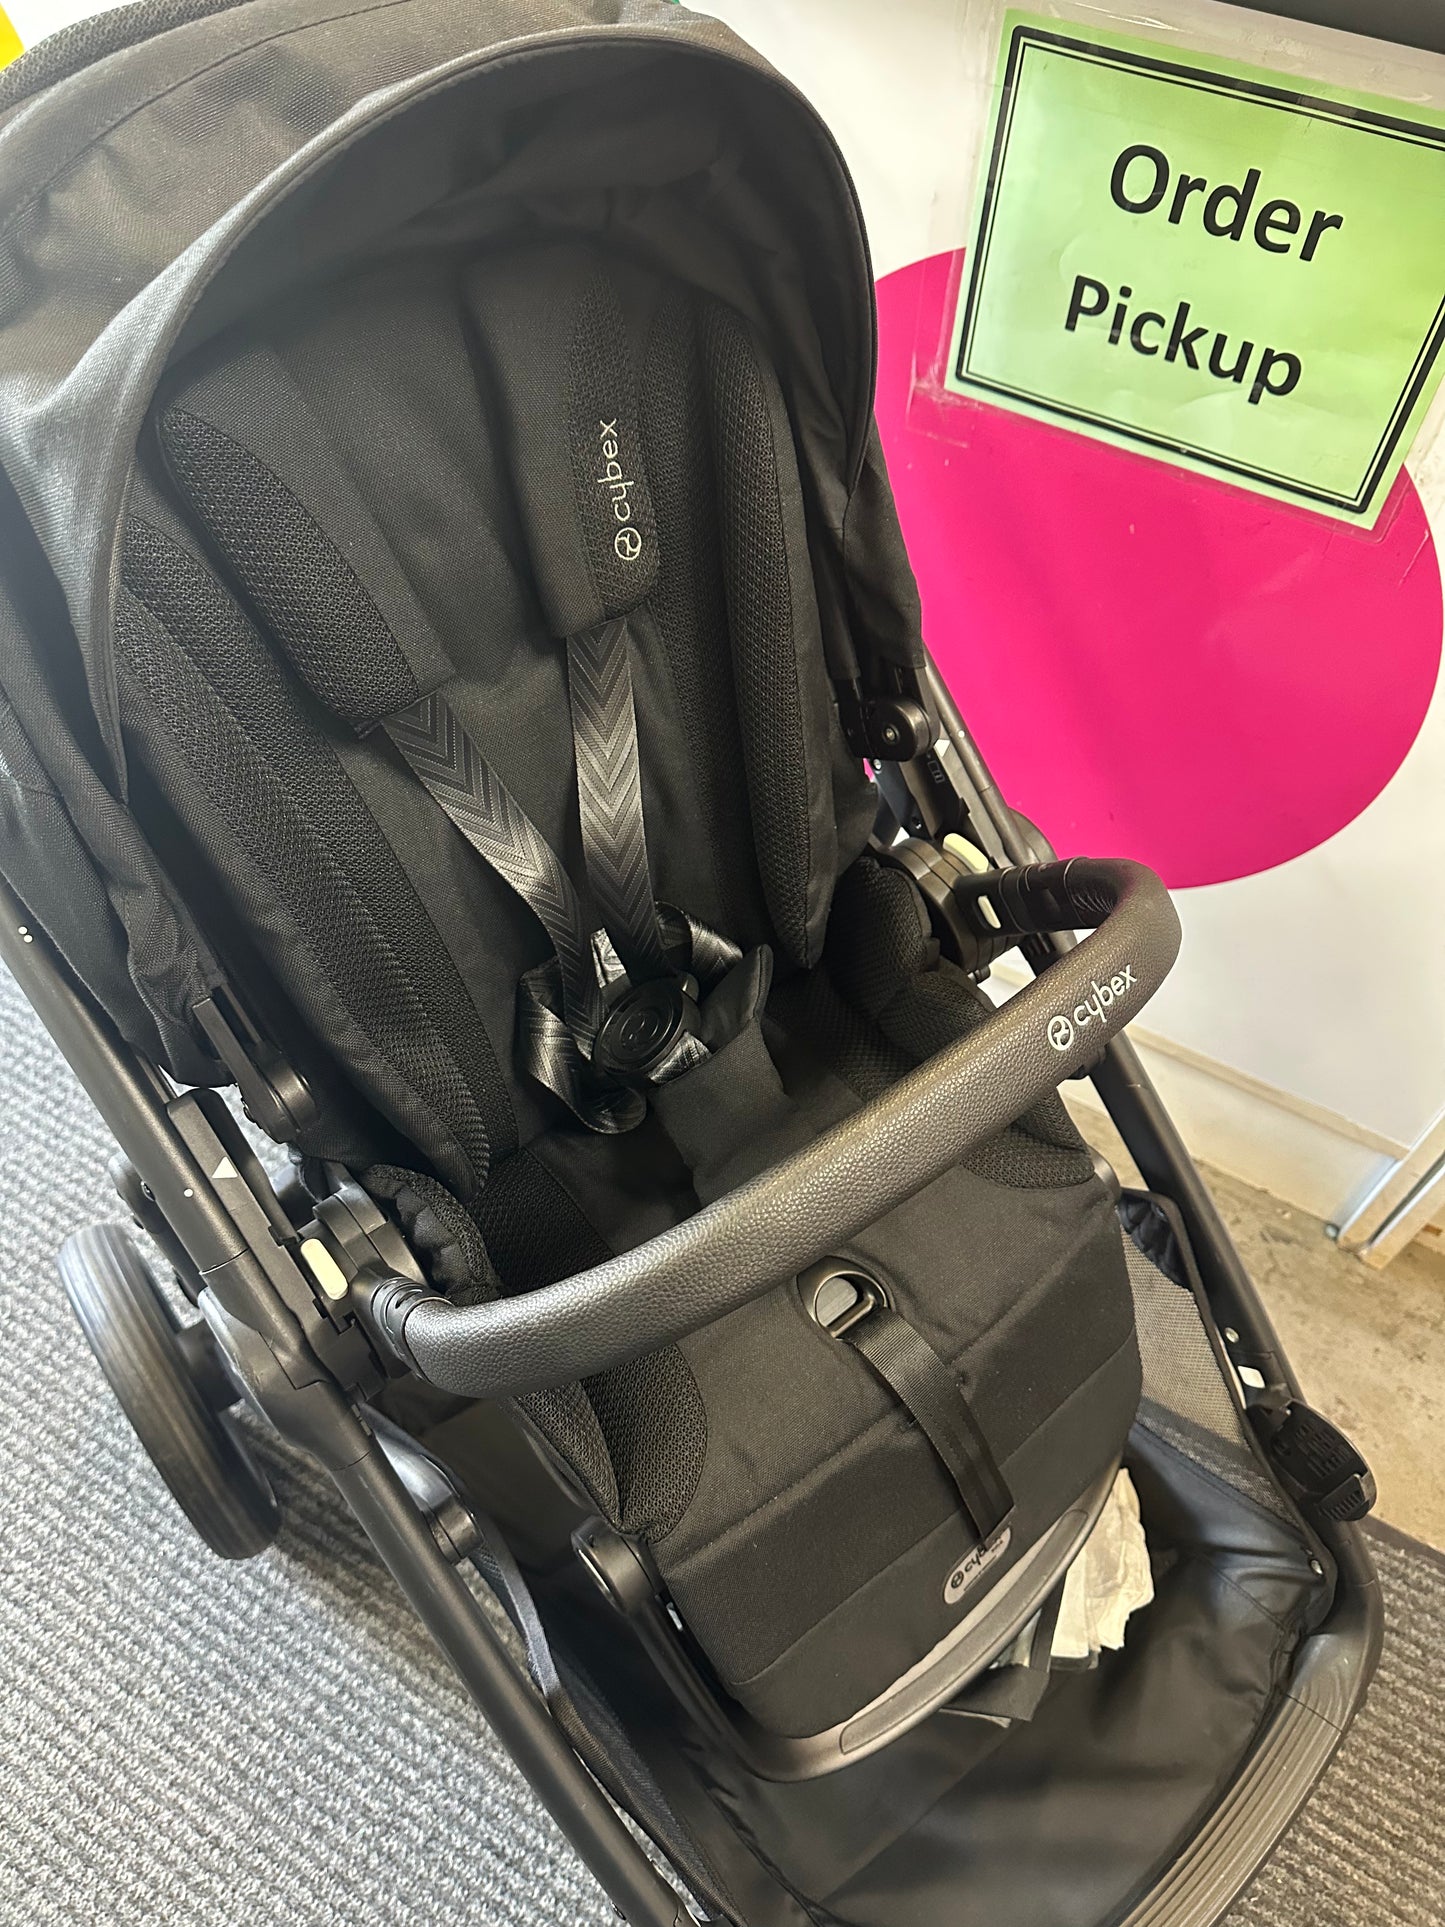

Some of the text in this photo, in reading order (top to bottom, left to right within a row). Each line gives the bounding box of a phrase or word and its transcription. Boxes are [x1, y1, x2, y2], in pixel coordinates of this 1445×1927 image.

[1110, 144, 1344, 262] Order
[1065, 275, 1302, 405] Pickup
[597, 418, 634, 521] cybex
[1073, 964, 1137, 1026] cybex
